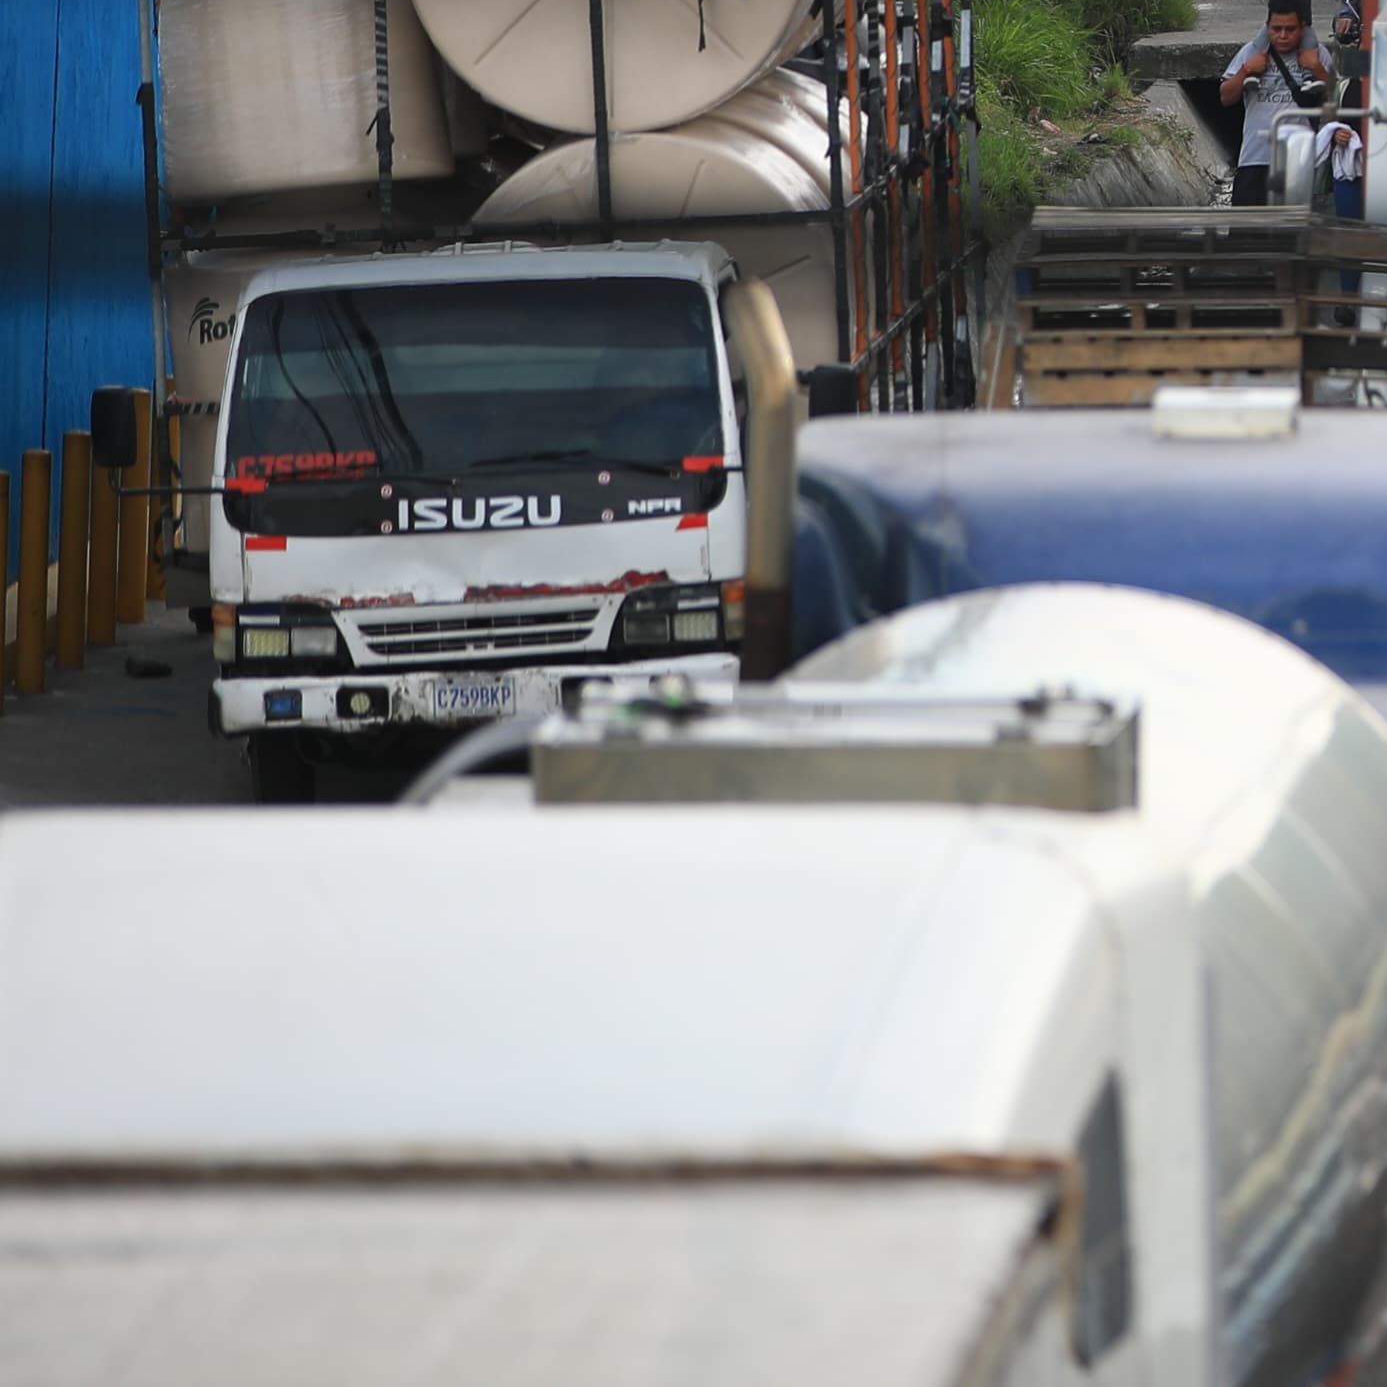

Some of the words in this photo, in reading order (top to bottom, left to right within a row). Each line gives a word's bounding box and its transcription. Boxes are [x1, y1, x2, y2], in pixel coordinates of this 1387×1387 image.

[398, 495, 562, 530] ISUZU
[628, 497, 682, 514] NPR
[437, 685, 511, 709] C759BKP
